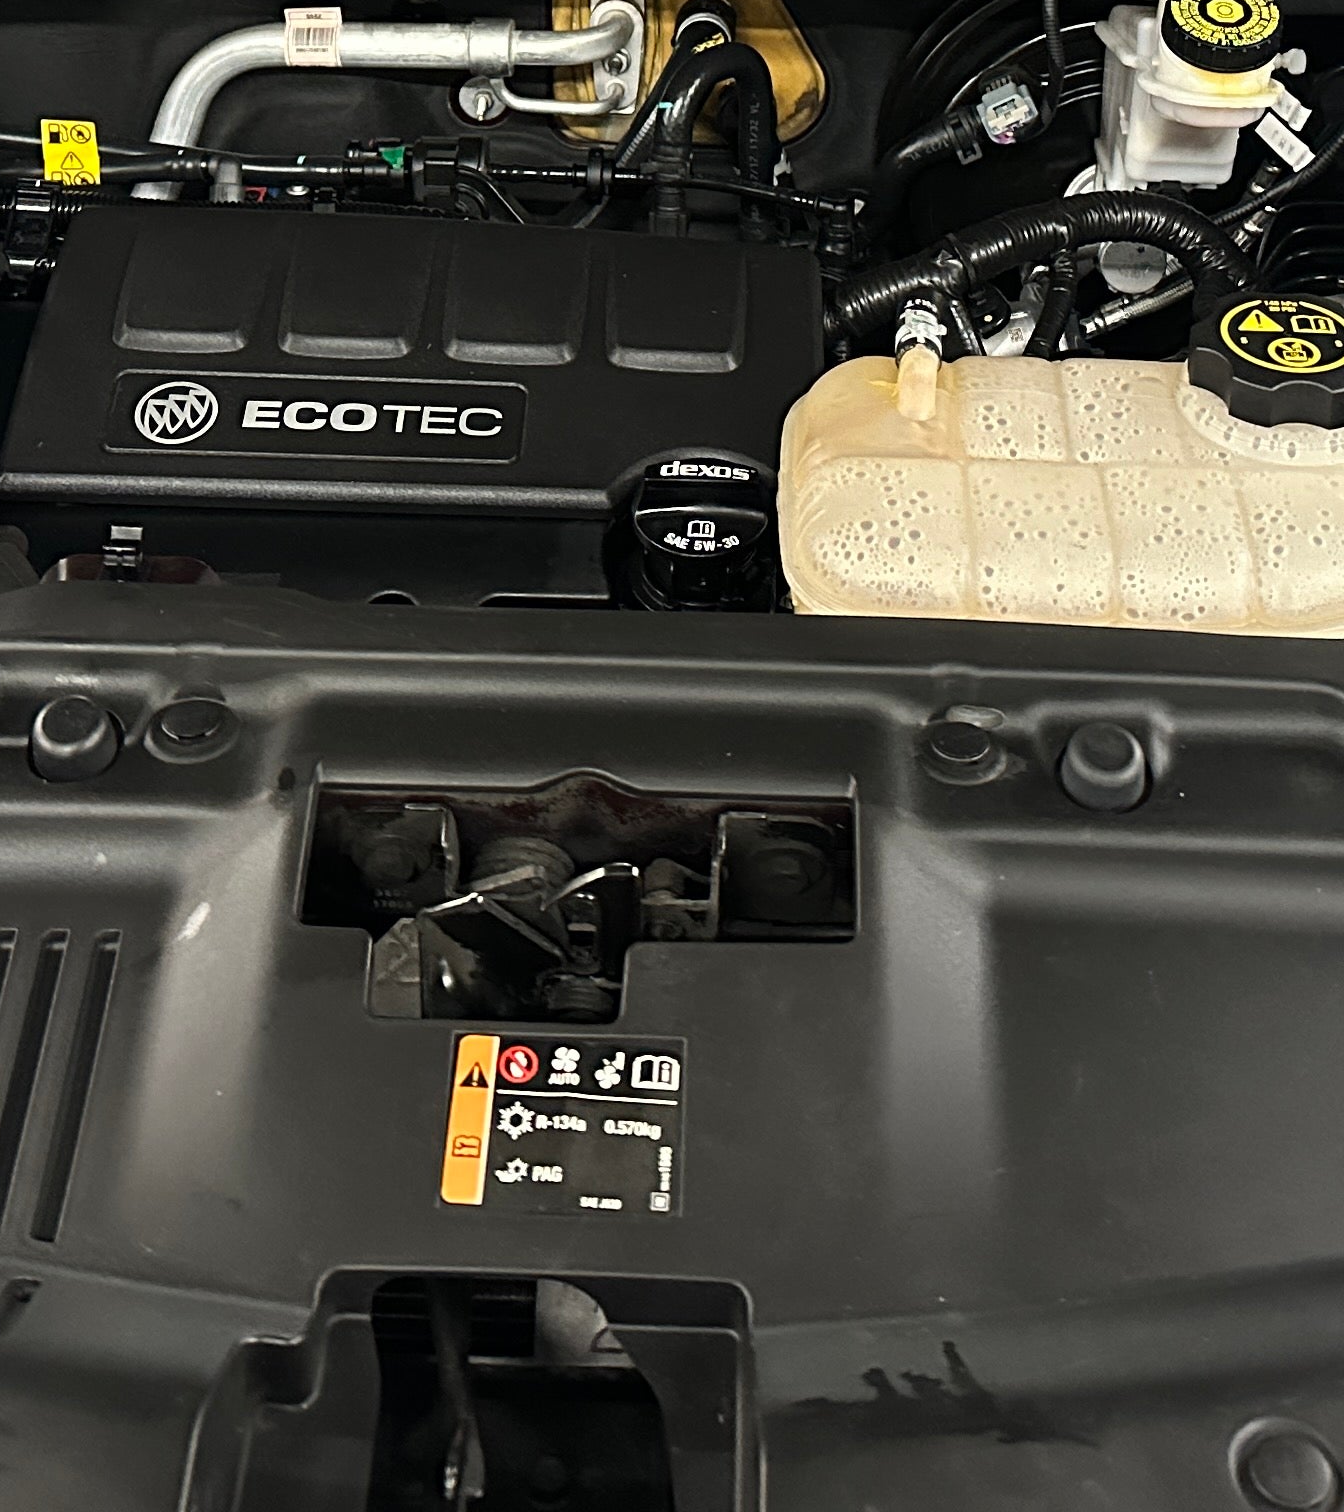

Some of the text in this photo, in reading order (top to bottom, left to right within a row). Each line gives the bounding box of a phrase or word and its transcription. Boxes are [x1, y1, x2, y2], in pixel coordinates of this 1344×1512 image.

[241, 399, 504, 437] ECOTEC
[659, 460, 750, 481] dexos
[663, 532, 740, 552] SAE 5W-30
[547, 1072, 581, 1086] AUTO
[534, 1113, 587, 1132] R-134a
[531, 1165, 564, 1183] PAG
